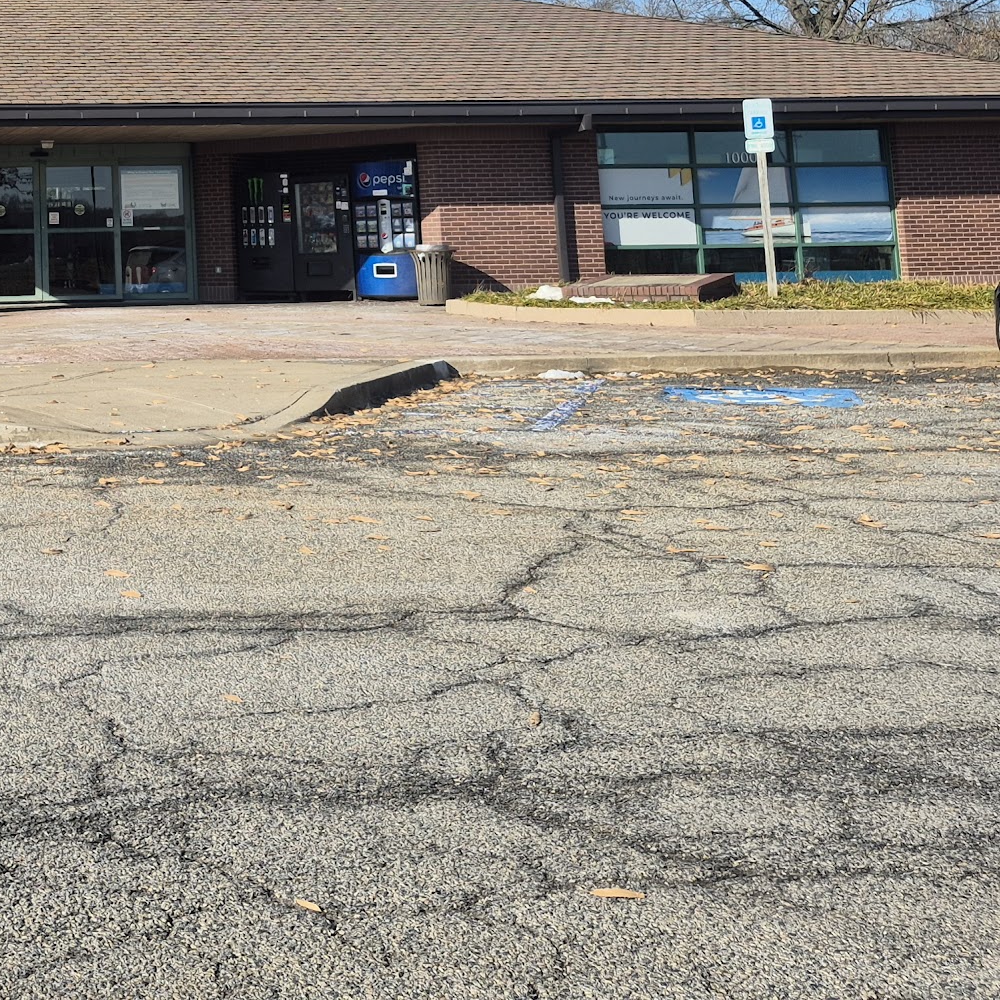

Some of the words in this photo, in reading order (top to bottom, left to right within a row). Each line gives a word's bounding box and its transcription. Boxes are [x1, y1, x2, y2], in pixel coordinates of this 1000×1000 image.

[372, 173, 405, 187] pepsi
[626, 194, 659, 202] journeys
[603, 211, 639, 219] YOU'RE
[641, 211, 691, 219] WELCOME
